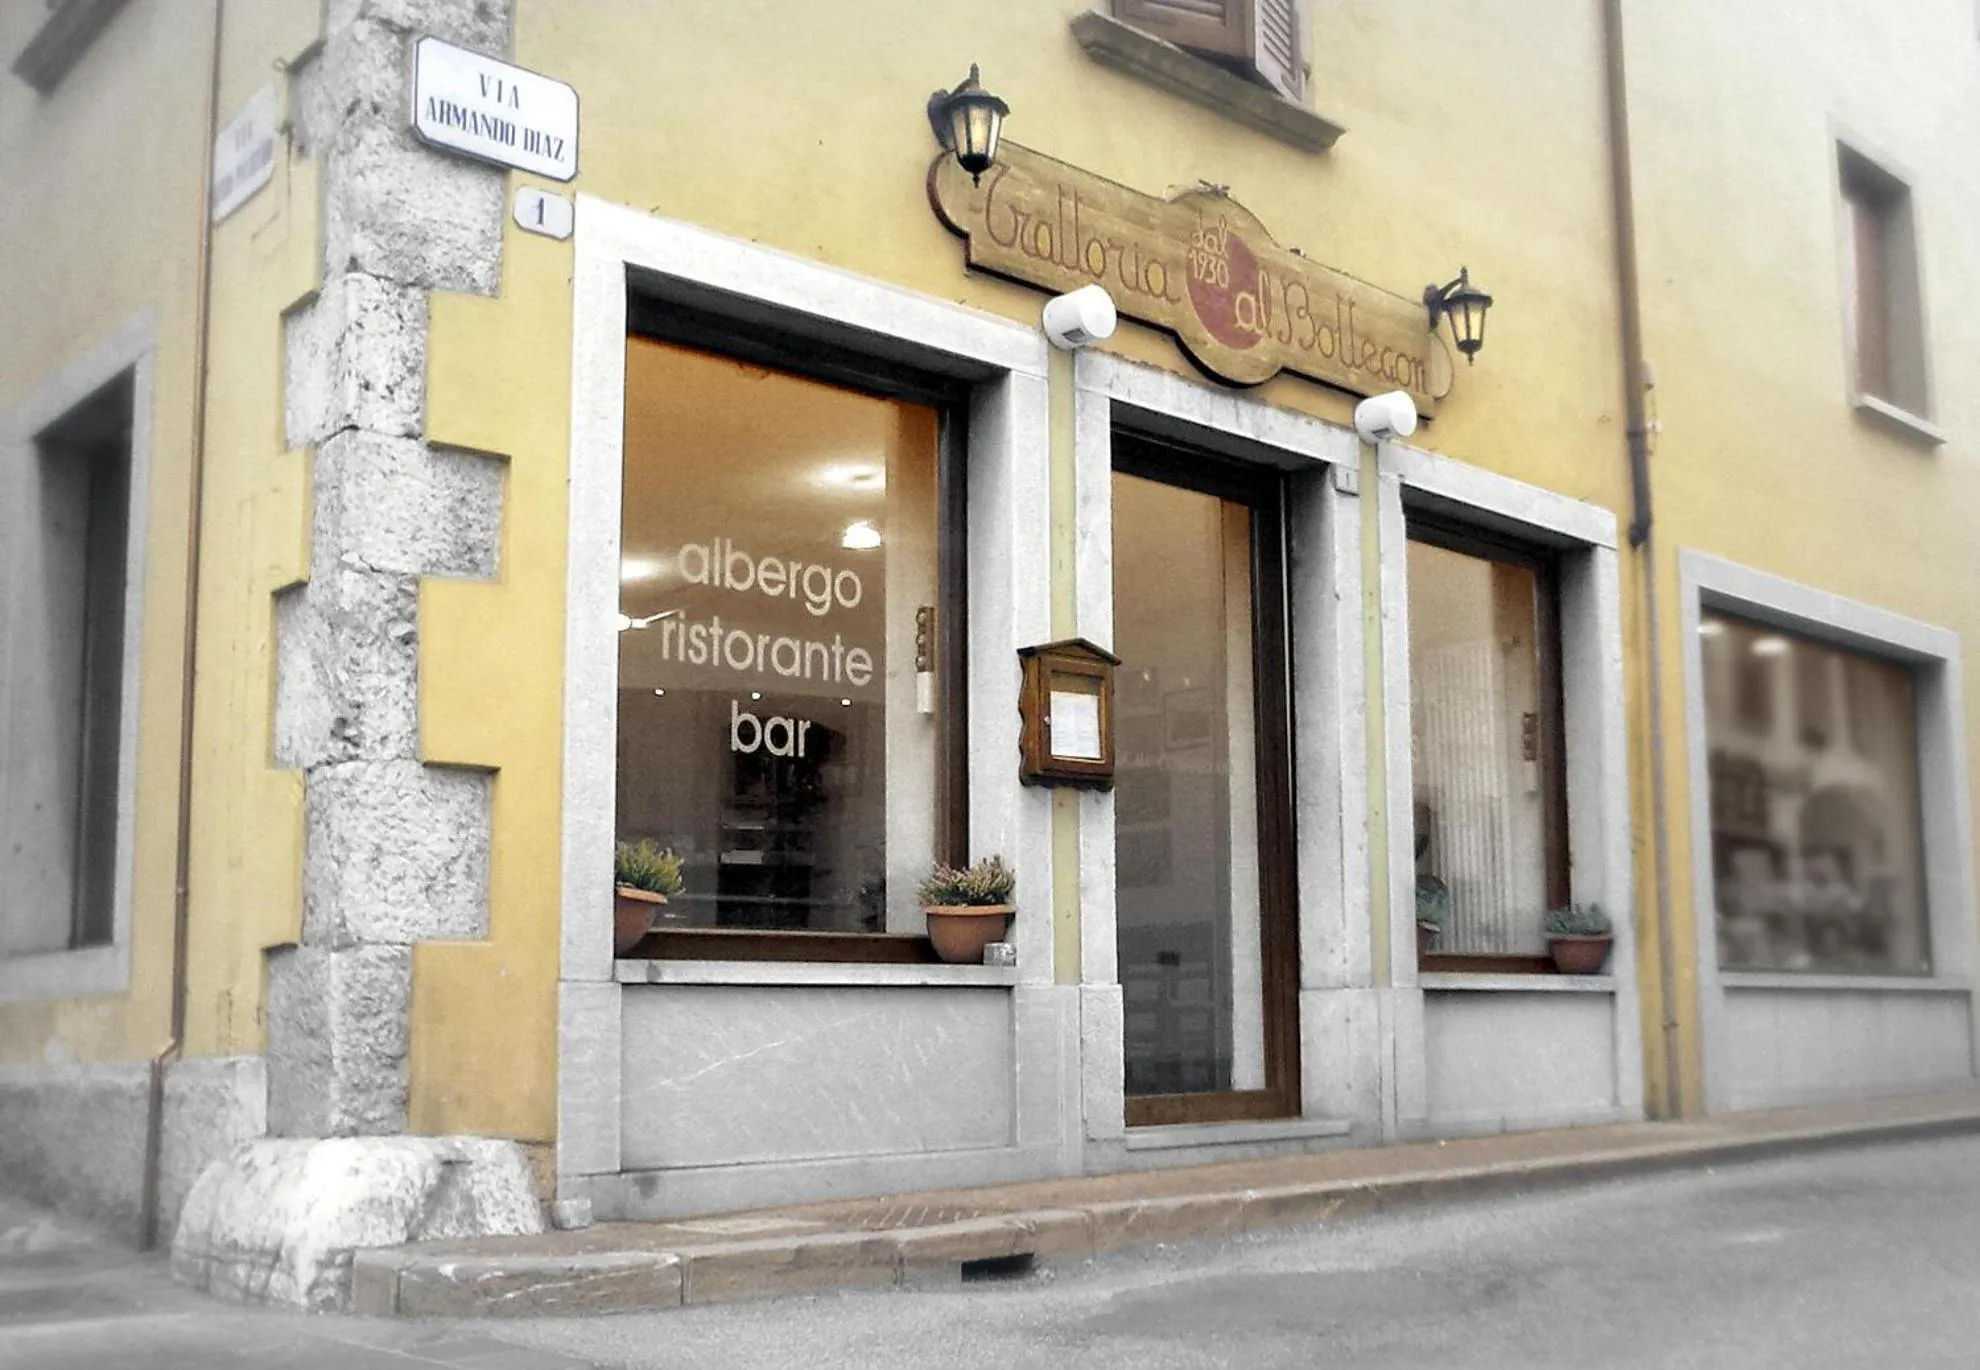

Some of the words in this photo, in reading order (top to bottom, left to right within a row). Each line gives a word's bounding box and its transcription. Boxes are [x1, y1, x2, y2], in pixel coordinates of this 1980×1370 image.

[479, 72, 520, 110] VIA
[425, 95, 516, 147] ARMANDO
[523, 126, 565, 163] DIAZ
[533, 197, 545, 226] 1
[986, 161, 1181, 303] Trattoria
[1188, 249, 1230, 289] 1930
[679, 536, 863, 617] albergo
[661, 610, 874, 687] ristorante
[731, 699, 811, 758] bar
